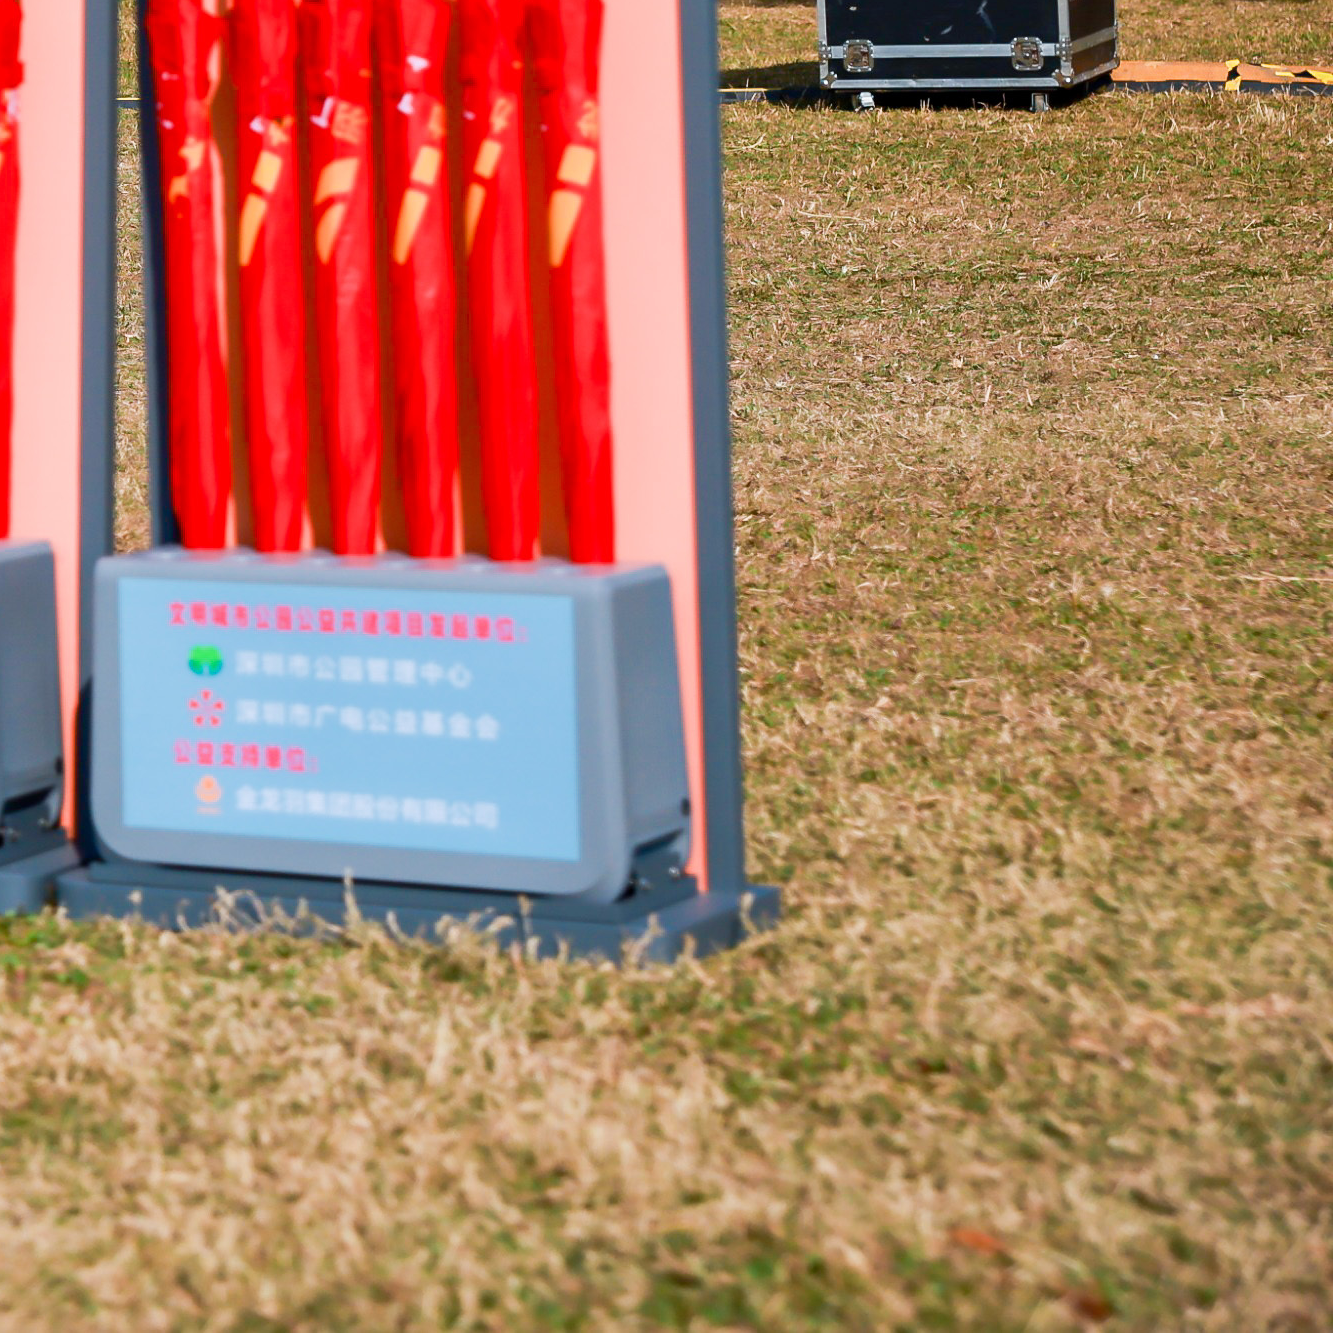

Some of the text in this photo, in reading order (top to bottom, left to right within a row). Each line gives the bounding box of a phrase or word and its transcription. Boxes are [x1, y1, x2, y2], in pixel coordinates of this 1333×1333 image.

[236, 650, 472, 690] 深圳市公园管理中心
